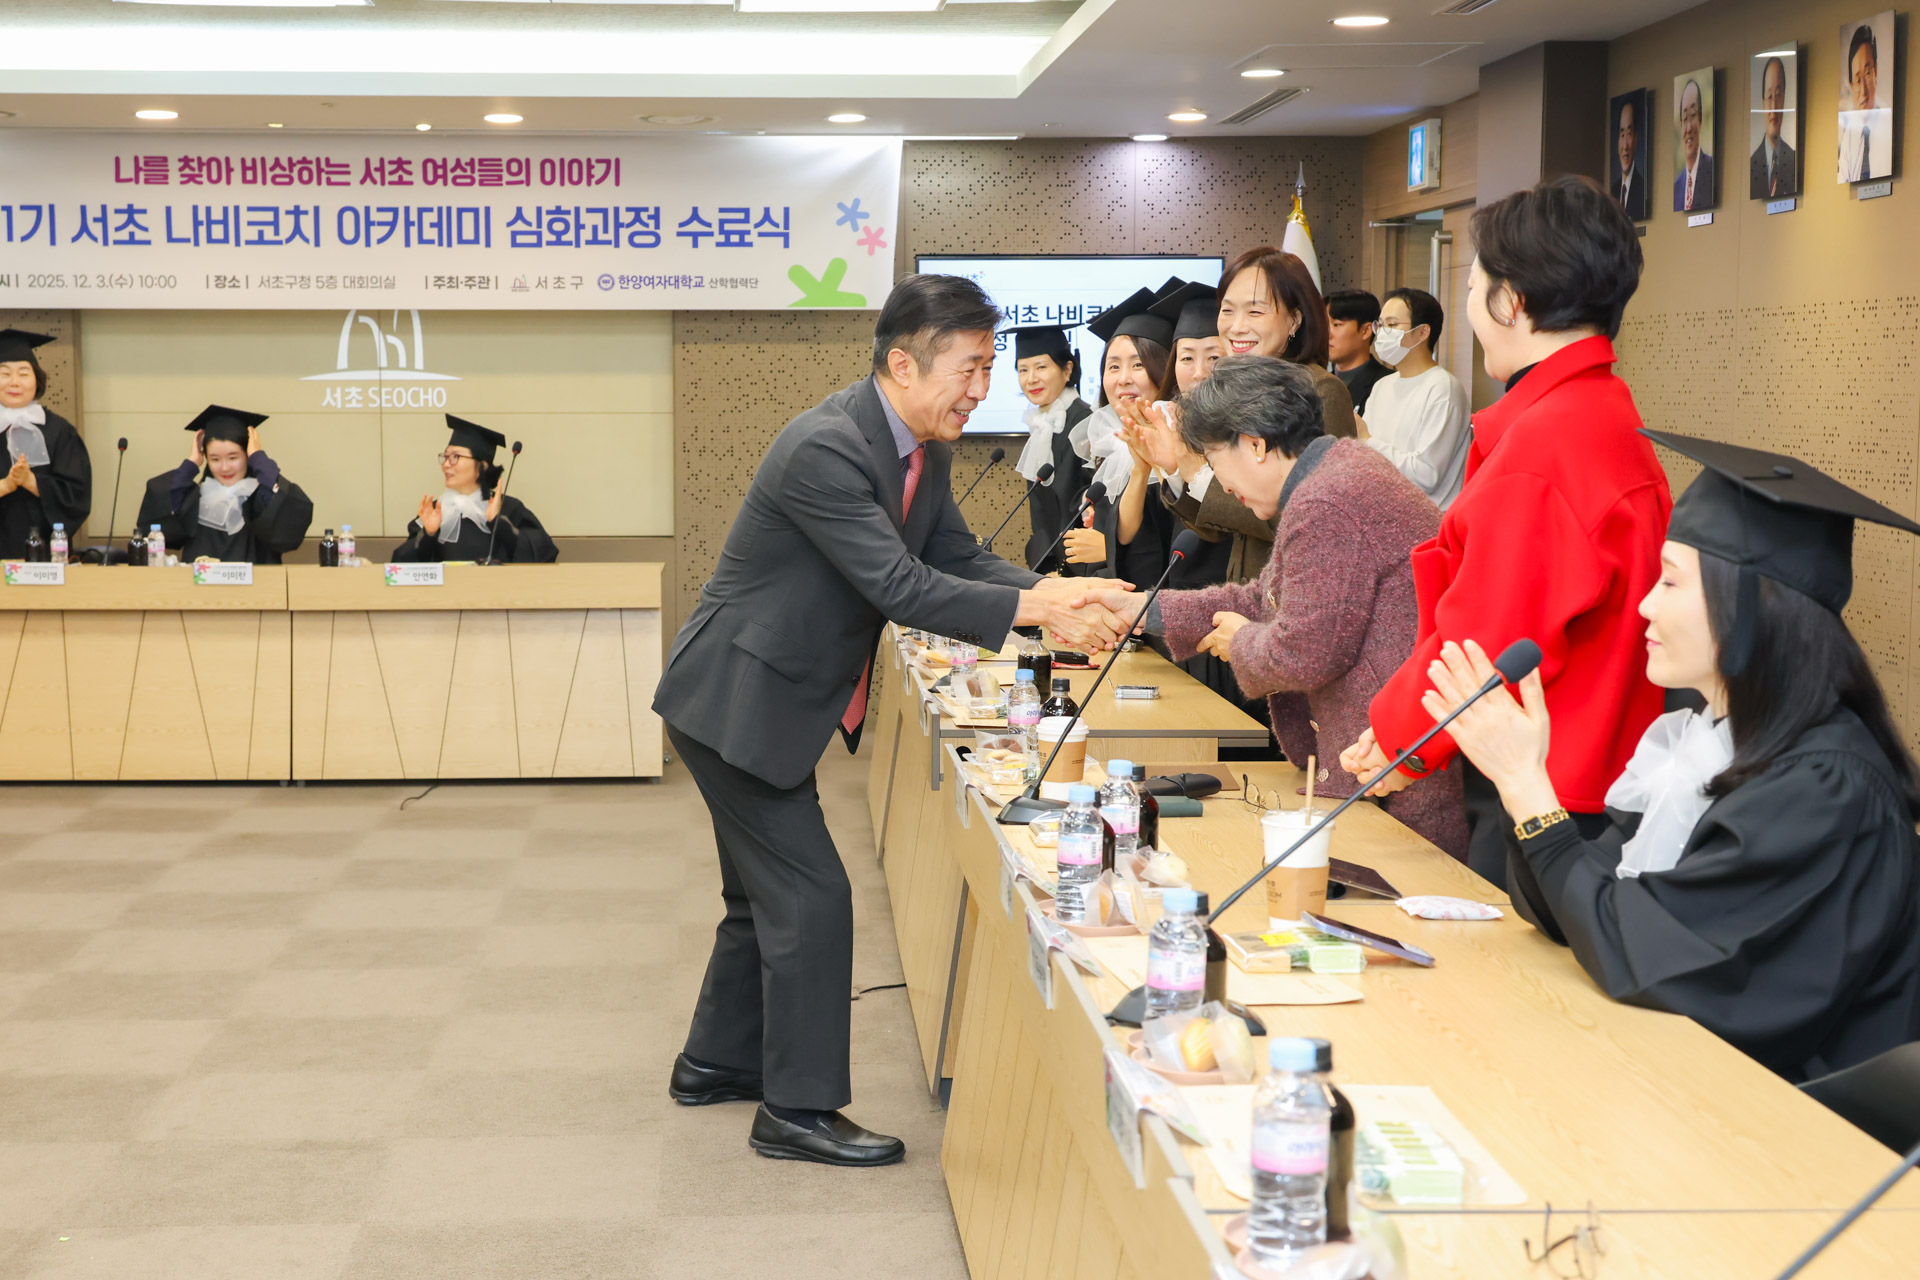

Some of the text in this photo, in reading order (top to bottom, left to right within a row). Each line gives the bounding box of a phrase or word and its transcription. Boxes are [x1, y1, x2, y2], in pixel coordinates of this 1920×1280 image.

[114, 155, 621, 187] 나를 찾아 비상하는 서초 여성들의 이야기
[1, 204, 790, 249] 1기 서초 나비코치 아카데미 심화과정 수료식
[28, 274, 70, 289] 2025.
[73, 274, 94, 289] 12.
[138, 274, 177, 289] 10:00
[257, 275, 311, 290] 서초구청
[315, 275, 338, 290] 5층
[343, 275, 396, 290] 대회의실
[617, 274, 706, 290] 한양여자대학교
[708, 277, 759, 289] 산학협력단
[1004, 304, 1114, 325] 서초 나비코
[322, 386, 447, 409] 서초 SEOCHO
